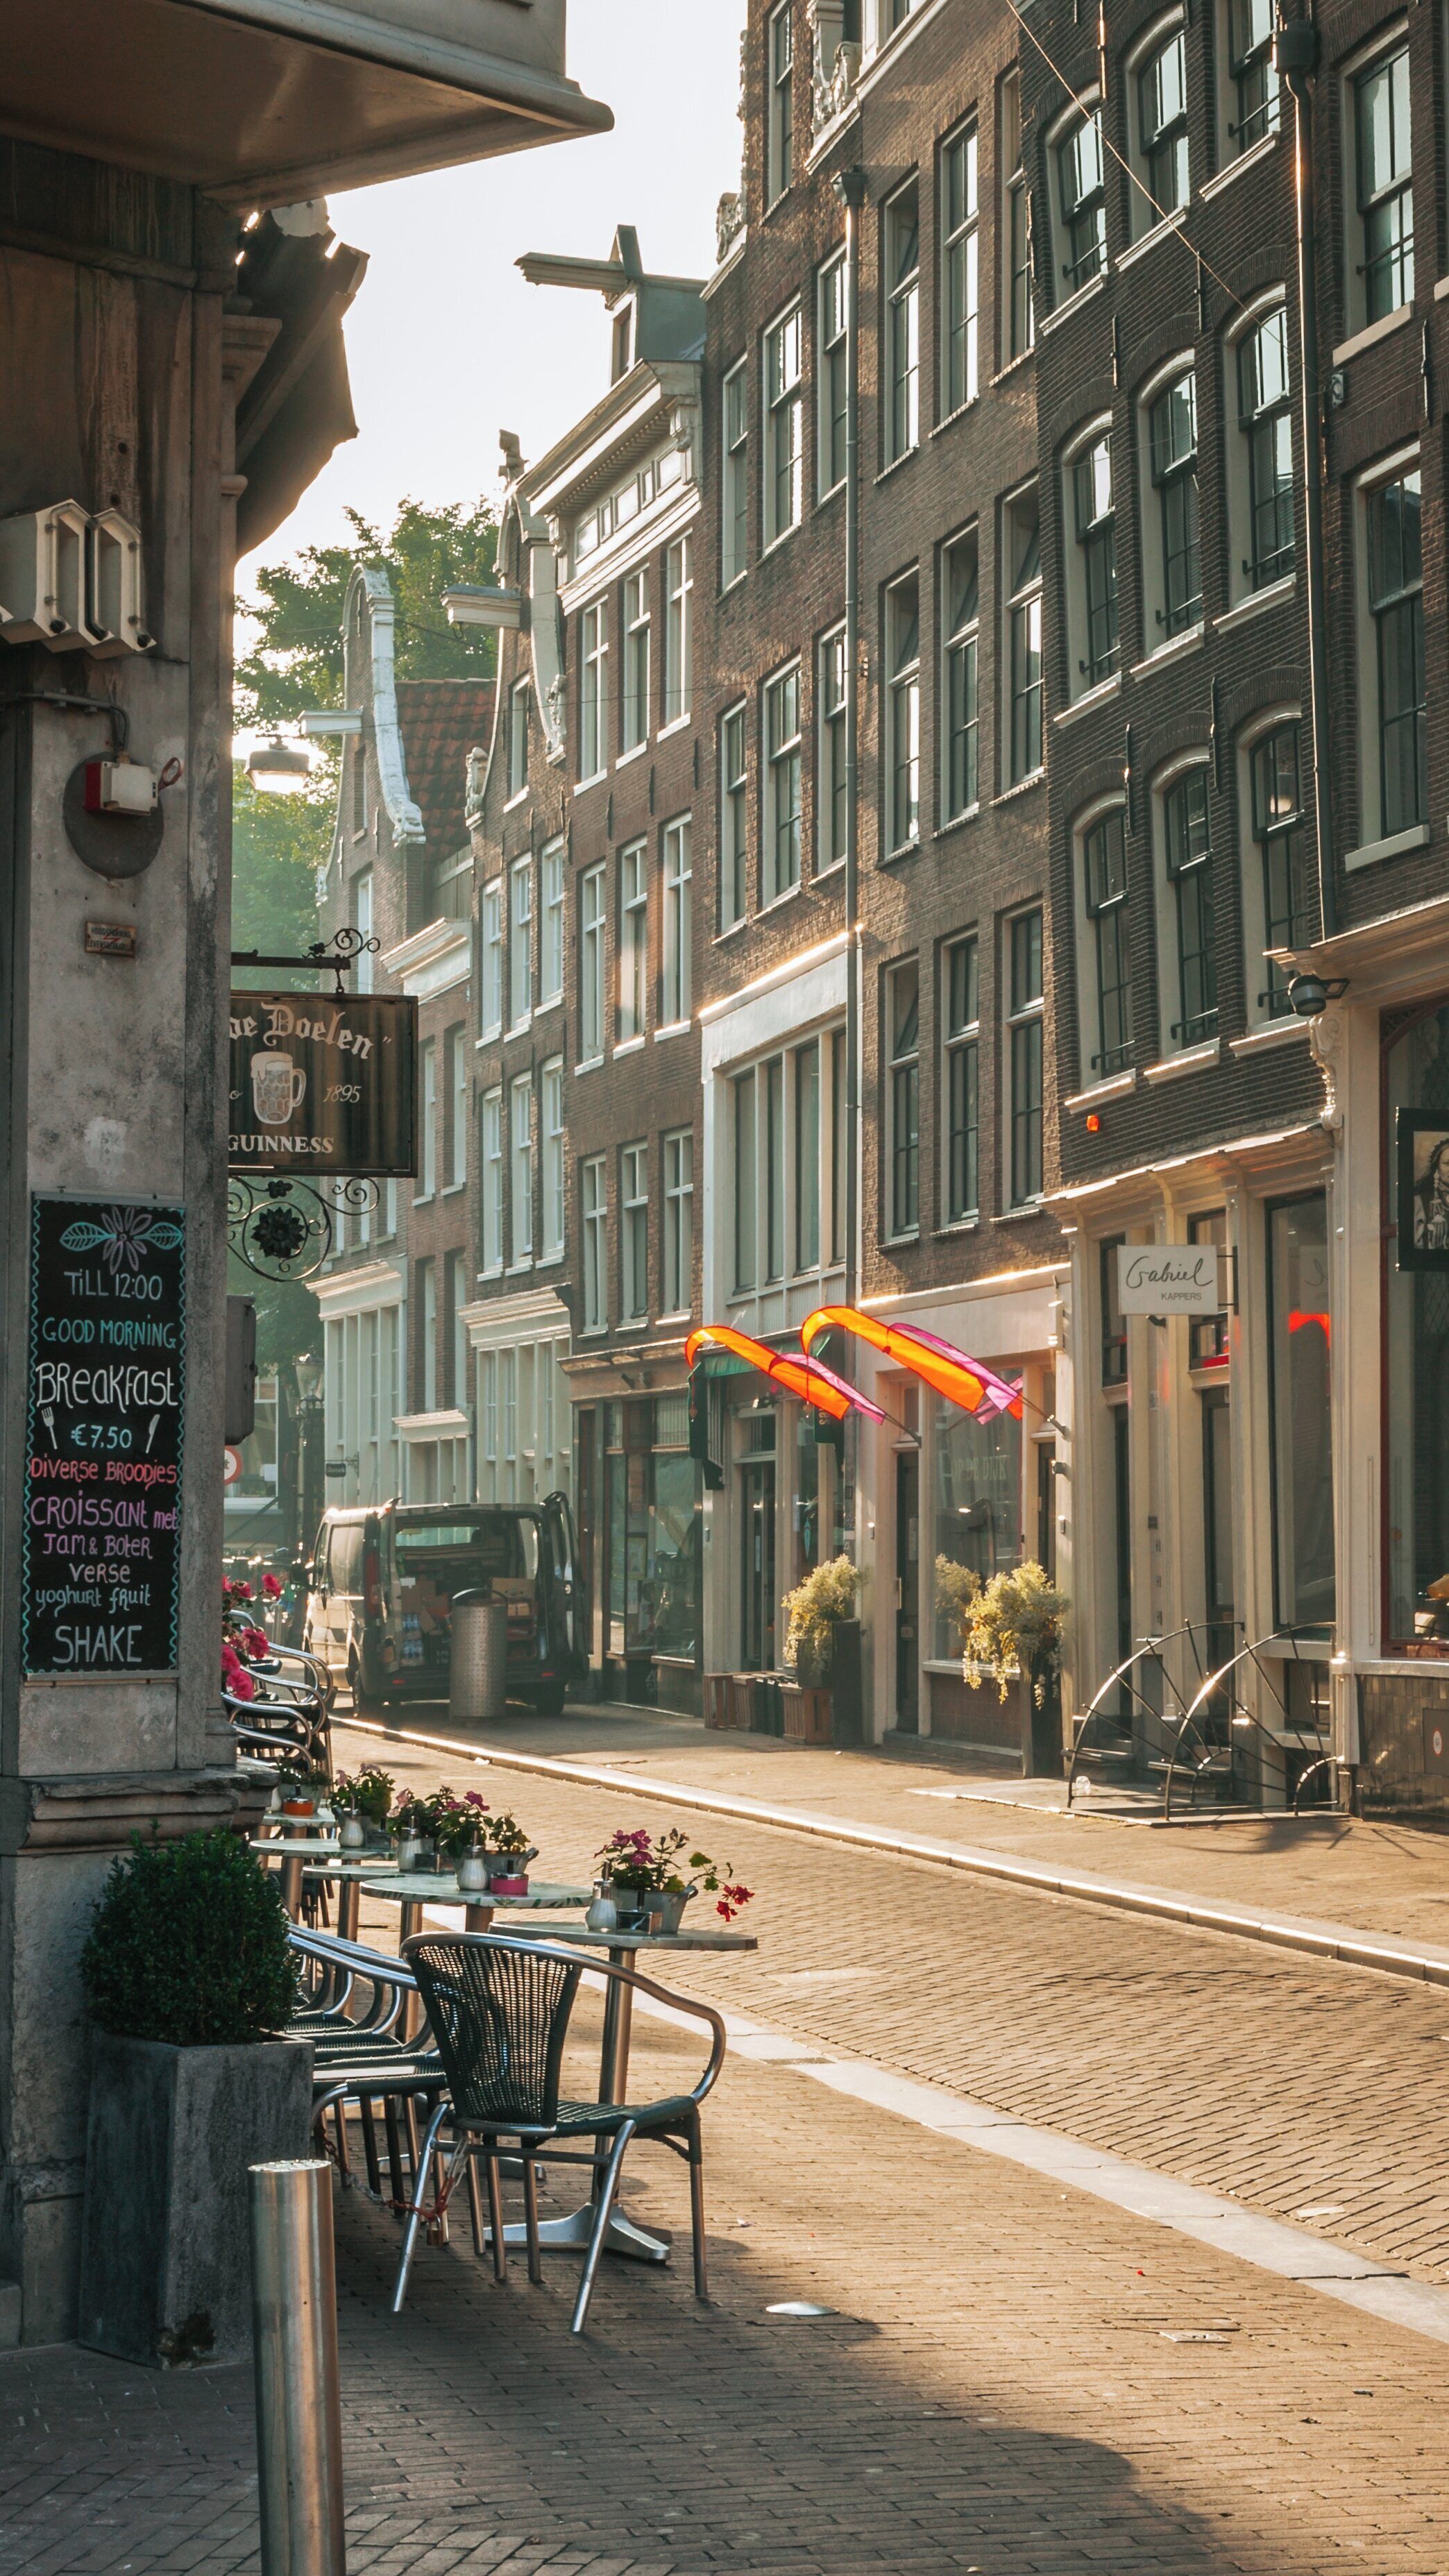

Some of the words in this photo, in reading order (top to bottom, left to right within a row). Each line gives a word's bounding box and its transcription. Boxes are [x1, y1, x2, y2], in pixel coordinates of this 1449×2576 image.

[323, 1084, 362, 1103] 1895
[228, 1134, 334, 1154] GUINNESS
[1126, 1255, 1214, 1289] Gabriel
[115, 1273, 163, 1300] 12:00
[1160, 1292, 1203, 1301] KAPPERS
[42, 1316, 95, 1344] GOOD
[153, 1507, 178, 1530] met
[89, 1536, 99, 1556] &
[52, 1625, 142, 1664] SHAKE
